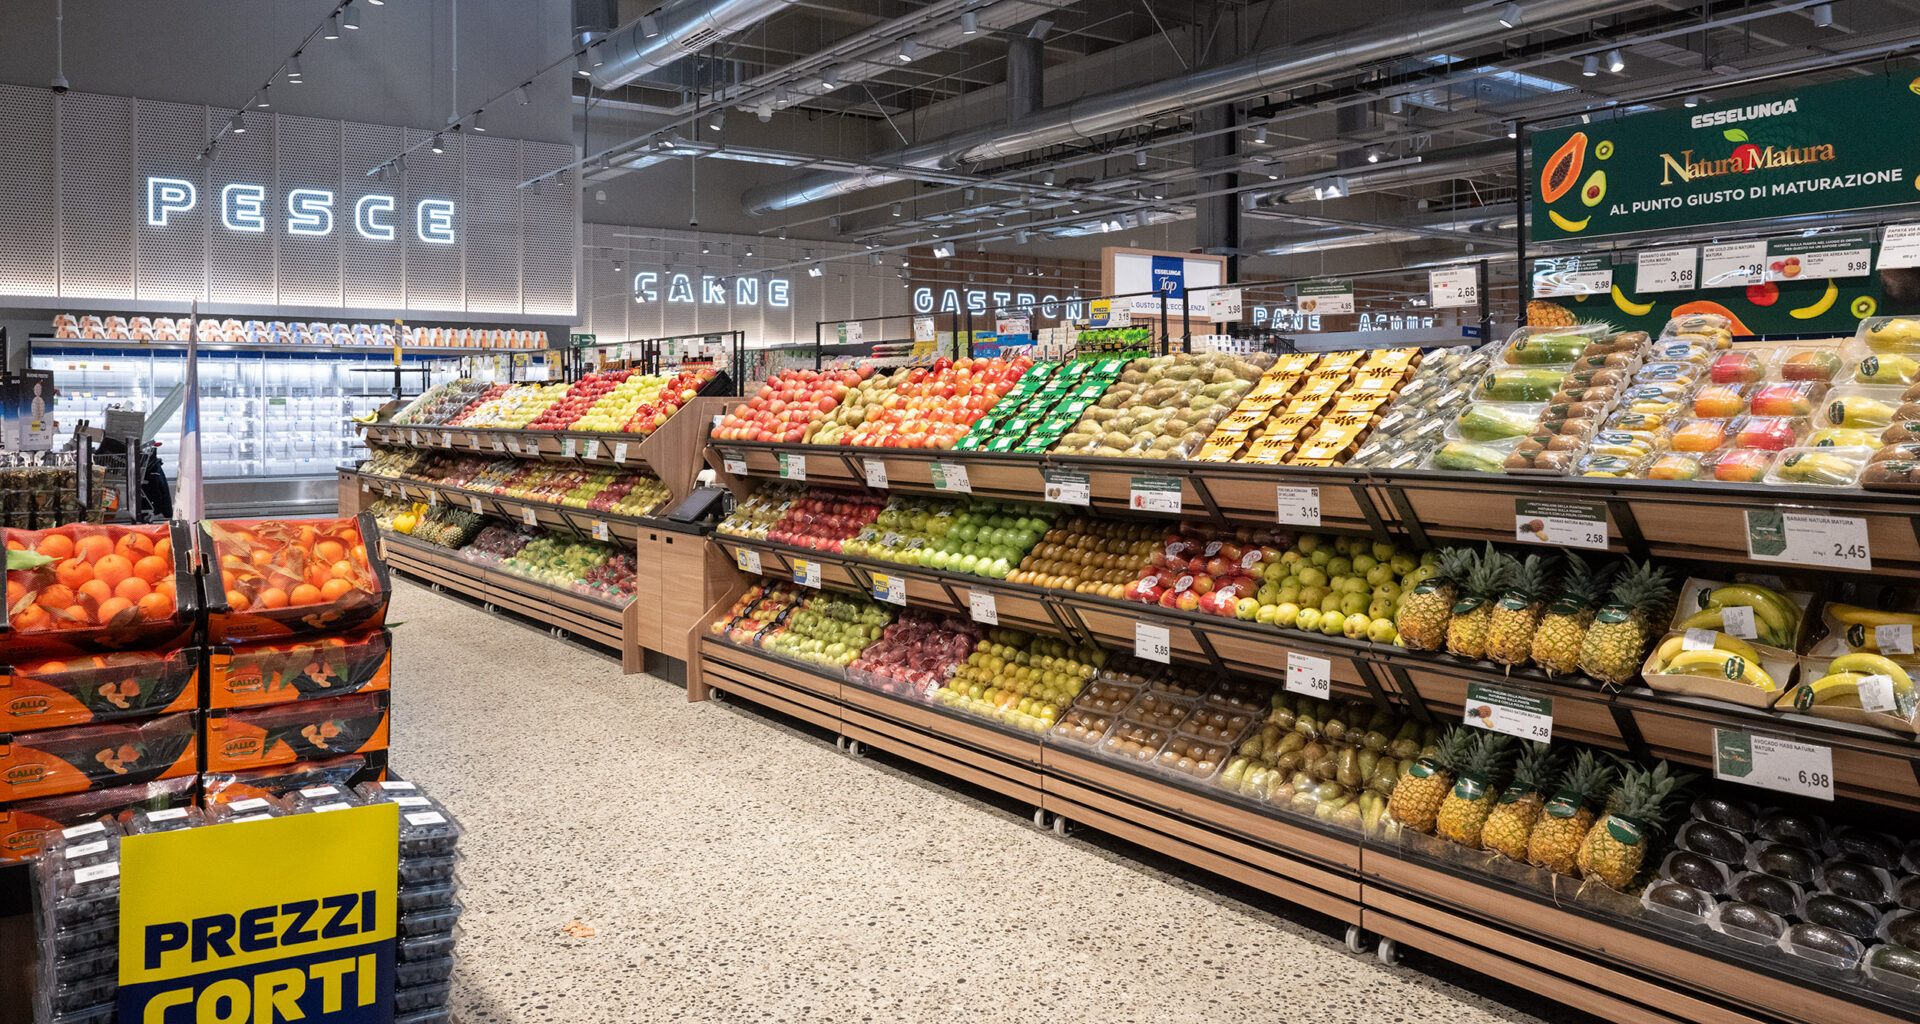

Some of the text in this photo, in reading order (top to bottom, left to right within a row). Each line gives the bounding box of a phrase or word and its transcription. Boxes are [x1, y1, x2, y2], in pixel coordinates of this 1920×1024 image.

[1660, 143, 1836, 186] Natura Matura
[1609, 168, 1903, 216] AL PUNTO GIUSTO DI MATURAZIONE
[147, 176, 455, 245] PESCE
[1848, 261, 1867, 272] 9,98
[1671, 270, 1693, 283] 3,68
[634, 271, 789, 307] CARNE
[1158, 276, 1177, 294] Top
[1595, 280, 1610, 289] 5,98
[1457, 287, 1475, 299] 2,68
[914, 287, 1092, 320] GASTRON
[1253, 307, 1321, 331] PANE
[1301, 507, 1318, 518] 3,15
[1586, 533, 1603, 544] 2,58
[1833, 543, 1866, 559] 2,45
[229, 677, 261, 688] GALLO
[1311, 677, 1328, 690] 3,68
[10, 700, 48, 711] GALLO
[1532, 725, 1549, 737] 2,58
[226, 741, 257, 751] GALLO
[1754, 739, 1779, 747] AVOCADO
[1794, 744, 1815, 753] NATURA
[1754, 745, 1775, 753] MATURA
[7, 767, 44, 779] GALLO
[1798, 770, 1829, 788] 6,98
[144, 889, 377, 970] PREZZI
[143, 952, 377, 1024] CORTI
